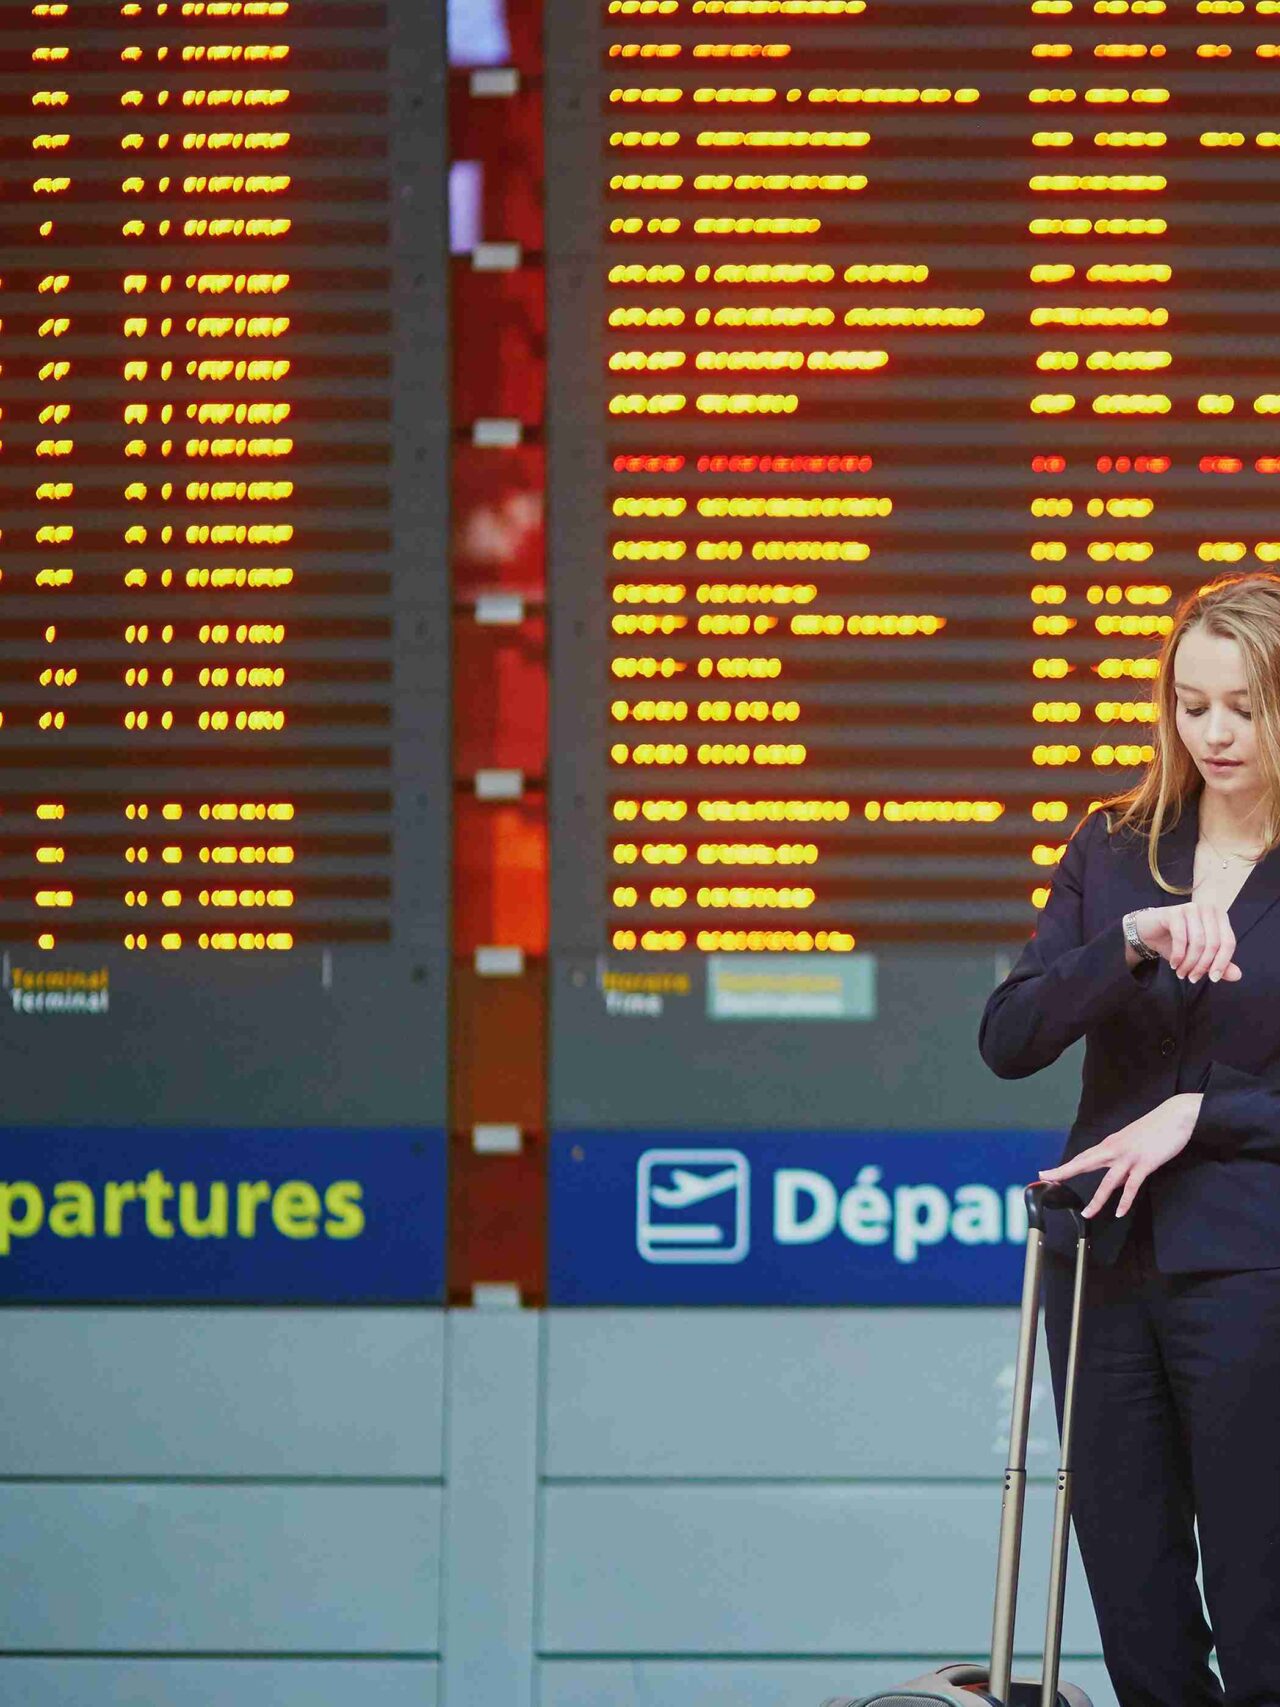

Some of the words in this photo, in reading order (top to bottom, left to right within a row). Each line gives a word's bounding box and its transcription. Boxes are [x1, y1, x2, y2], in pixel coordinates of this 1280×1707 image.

[11, 988, 109, 1014] Terminal
[0, 1169, 365, 1256] partures
[772, 1166, 1028, 1264] Dépar
